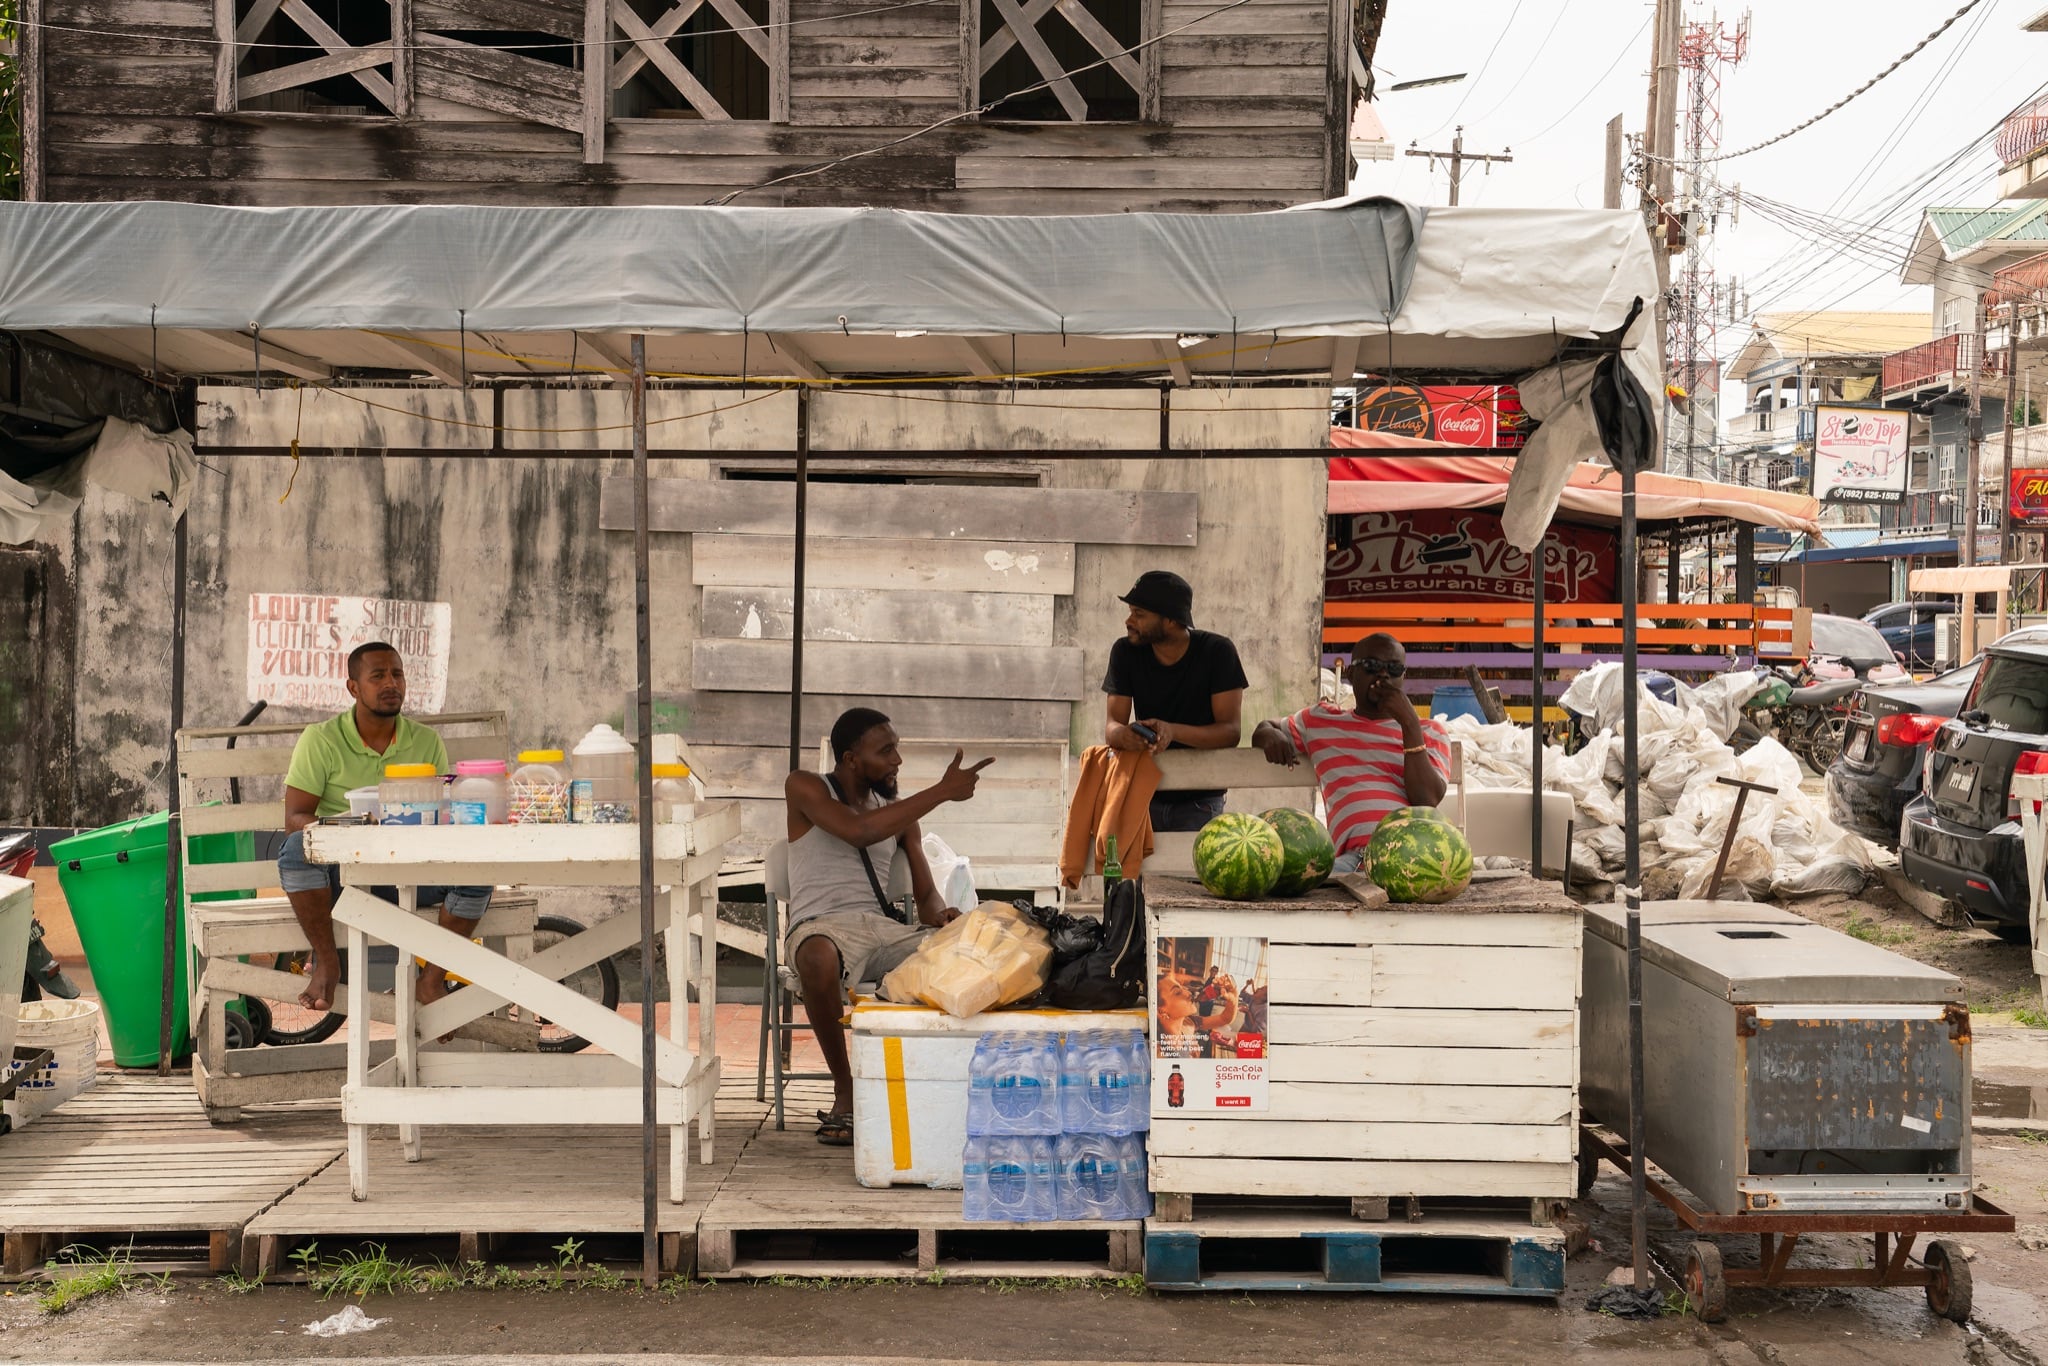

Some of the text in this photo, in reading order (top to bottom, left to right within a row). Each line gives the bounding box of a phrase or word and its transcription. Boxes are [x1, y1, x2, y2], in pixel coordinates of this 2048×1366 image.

[1873, 417, 1902, 446] Top
[1843, 489, 1863, 500] (592)
[1347, 576, 1535, 595] Restaurant & Ba
[252, 595, 435, 628] LOUTIE SCHOOL
[256, 622, 343, 651] CLOTHES
[379, 627, 438, 658] SCHOOL
[1215, 1064, 1263, 1073] Coca-Cola
[1215, 1073, 1262, 1081] 355ml for
[1215, 1080, 1222, 1089] $
